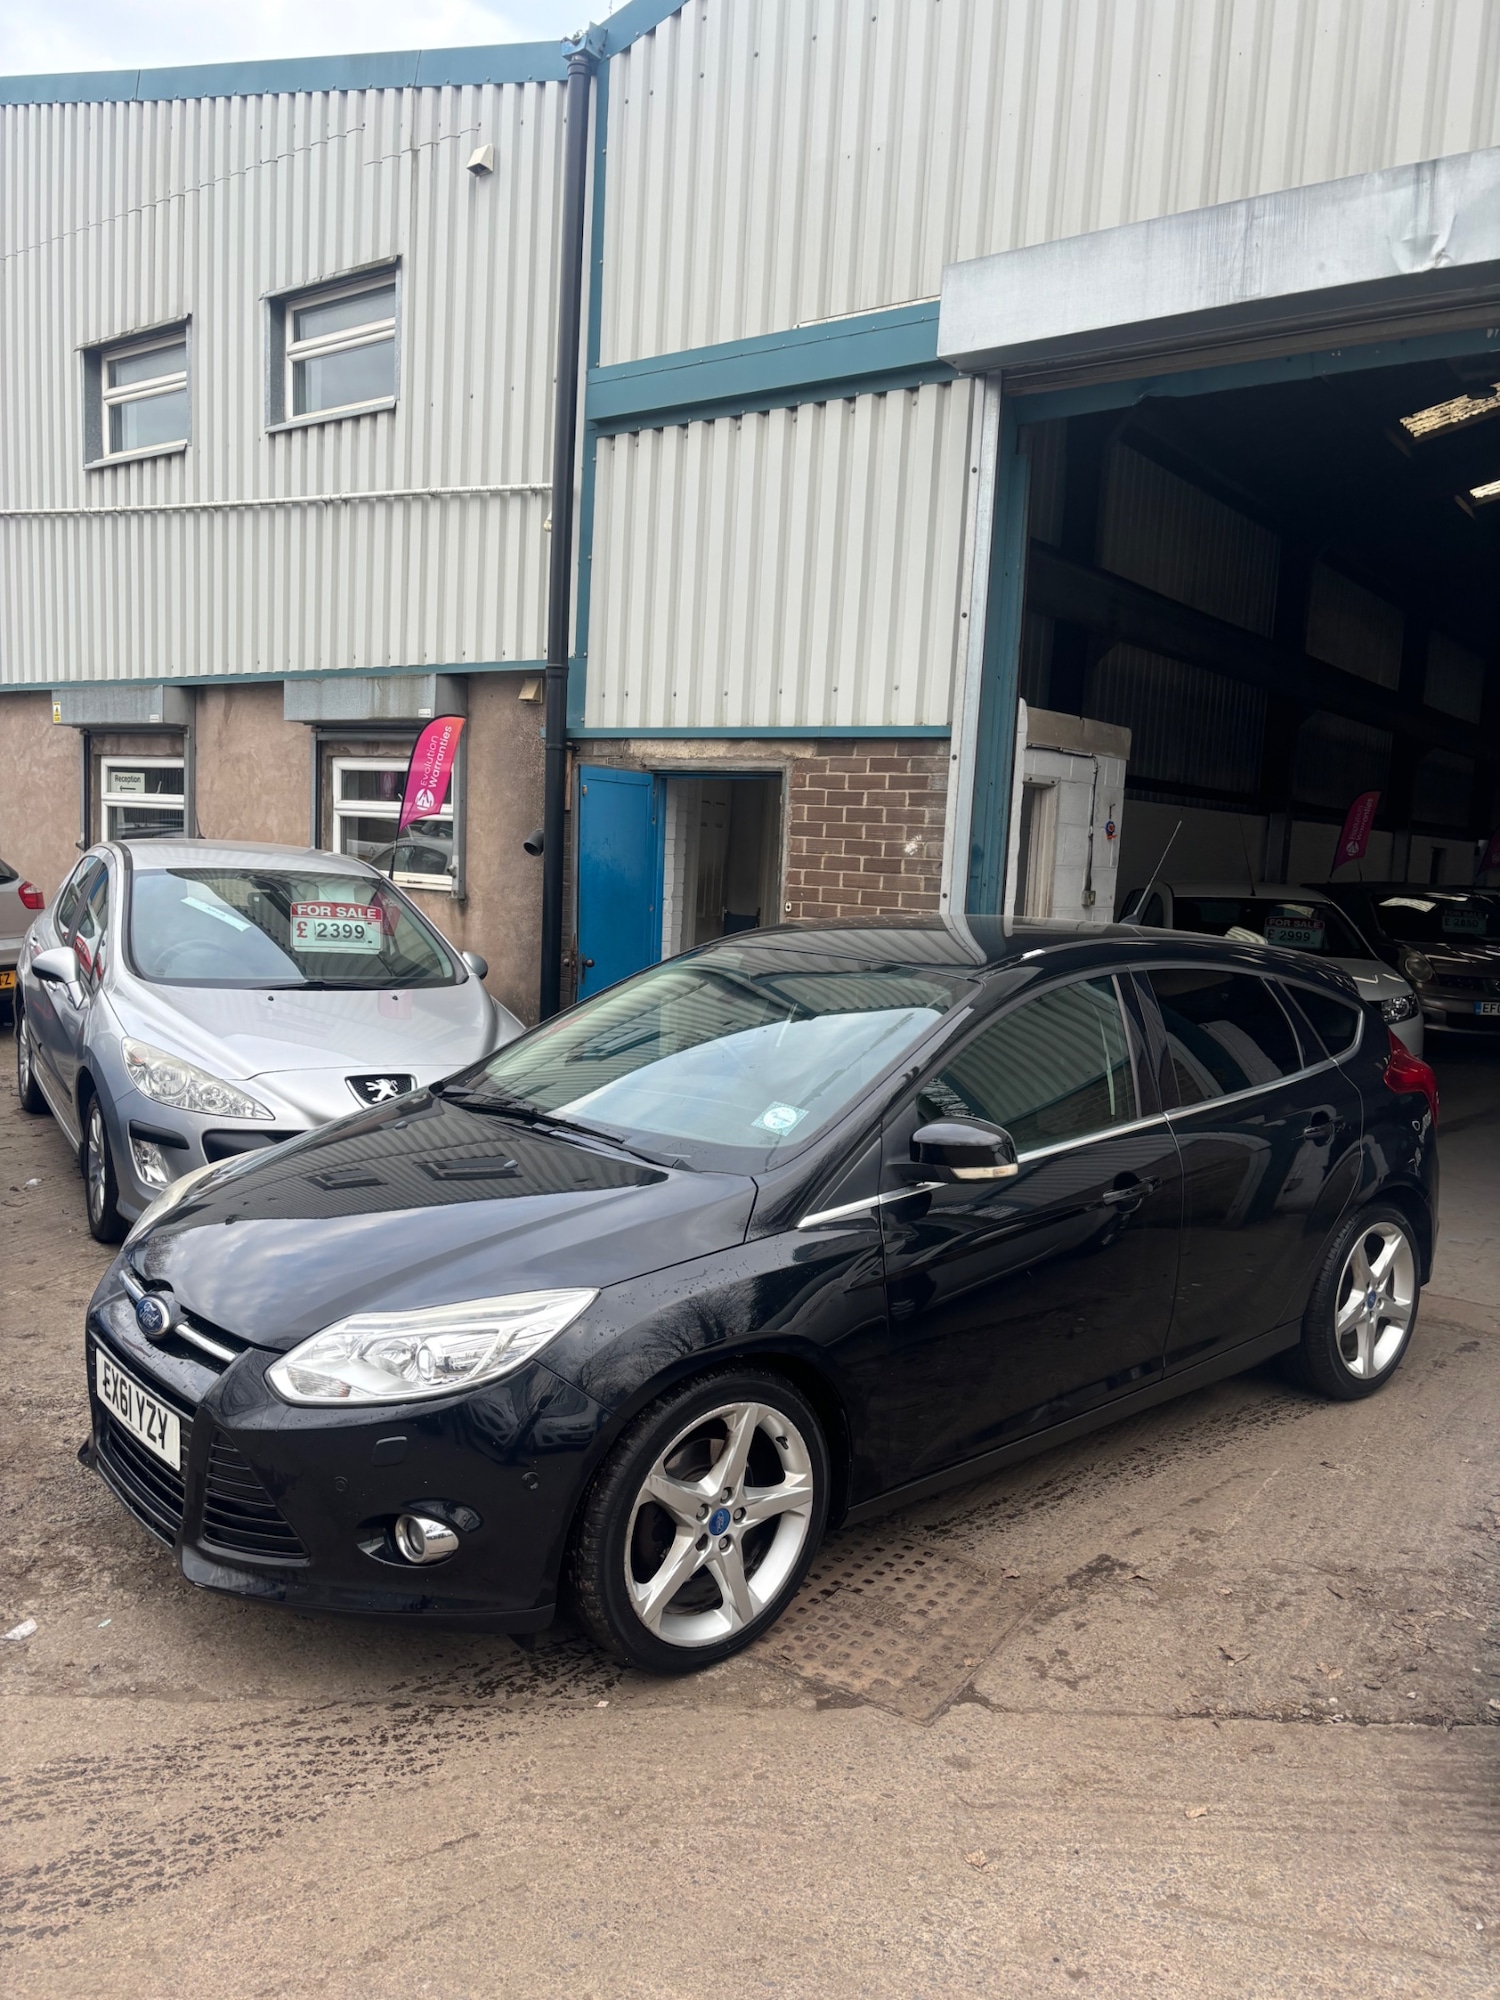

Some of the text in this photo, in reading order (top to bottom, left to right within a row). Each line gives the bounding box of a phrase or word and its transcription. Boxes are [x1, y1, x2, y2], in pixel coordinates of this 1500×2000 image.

[420, 735, 438, 786] Evolution
[428, 725, 452, 788] Warranties
[114, 774, 141, 784] Reception
[297, 904, 377, 919] FOR SALE
[296, 921, 365, 939] £ 2399
[1269, 918, 1320, 929] FOR SALE
[1279, 930, 1311, 941] 2999
[139, 1301, 159, 1328] Ford
[102, 1360, 168, 1451] EX61 YZY
